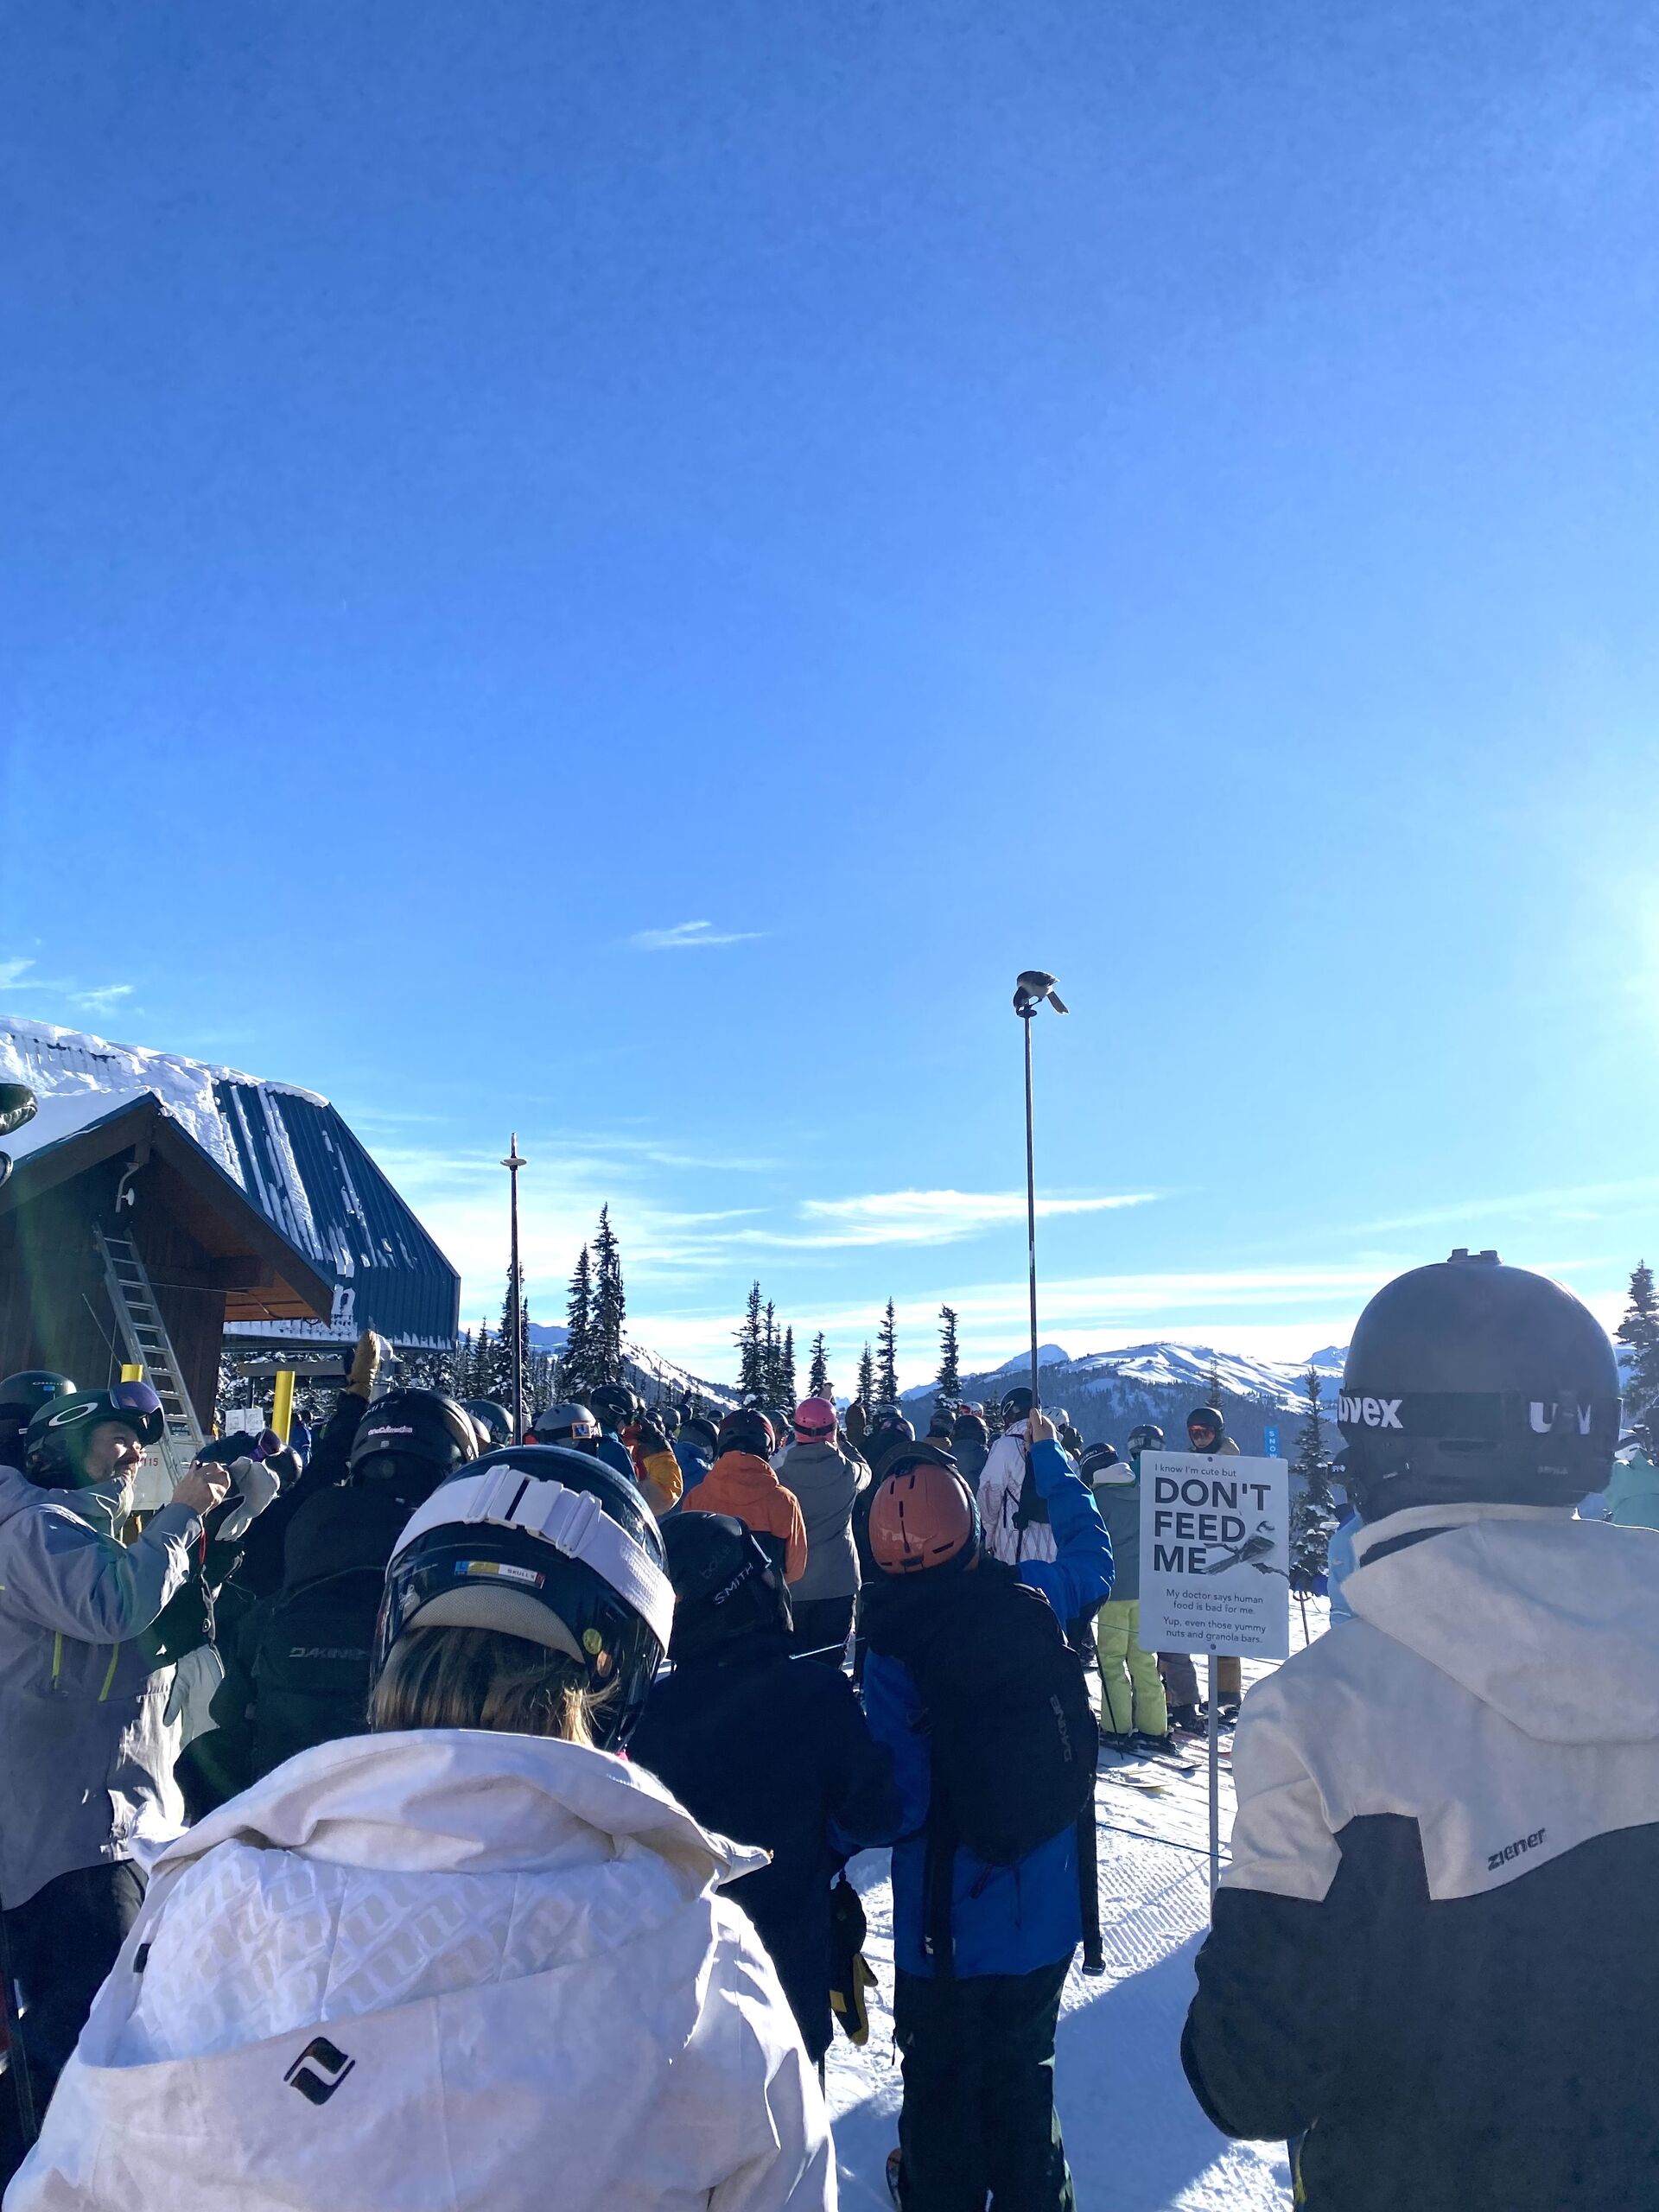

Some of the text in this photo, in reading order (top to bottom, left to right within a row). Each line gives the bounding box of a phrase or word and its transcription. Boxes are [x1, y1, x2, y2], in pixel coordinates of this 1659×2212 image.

[1222, 1468, 1236, 1477] but
[1154, 1477, 1271, 1510] DON'T
[1154, 1510, 1246, 1542] FEED
[1154, 1544, 1207, 1574] ME
[714, 1562, 753, 1605] SMITH
[1166, 1589, 1263, 1604] My doctor says human
[1173, 1600, 1193, 1610] food
[1196, 1602, 1203, 1611] is
[1205, 1603, 1223, 1612] bad
[1225, 1605, 1237, 1613] for
[1163, 1617, 1182, 1627] Yup,
[1208, 1620, 1232, 1629] those
[1235, 1624, 1266, 1634] yummy
[1205, 1633, 1239, 1642] granola
[1488, 1827, 1546, 1871] ziener
